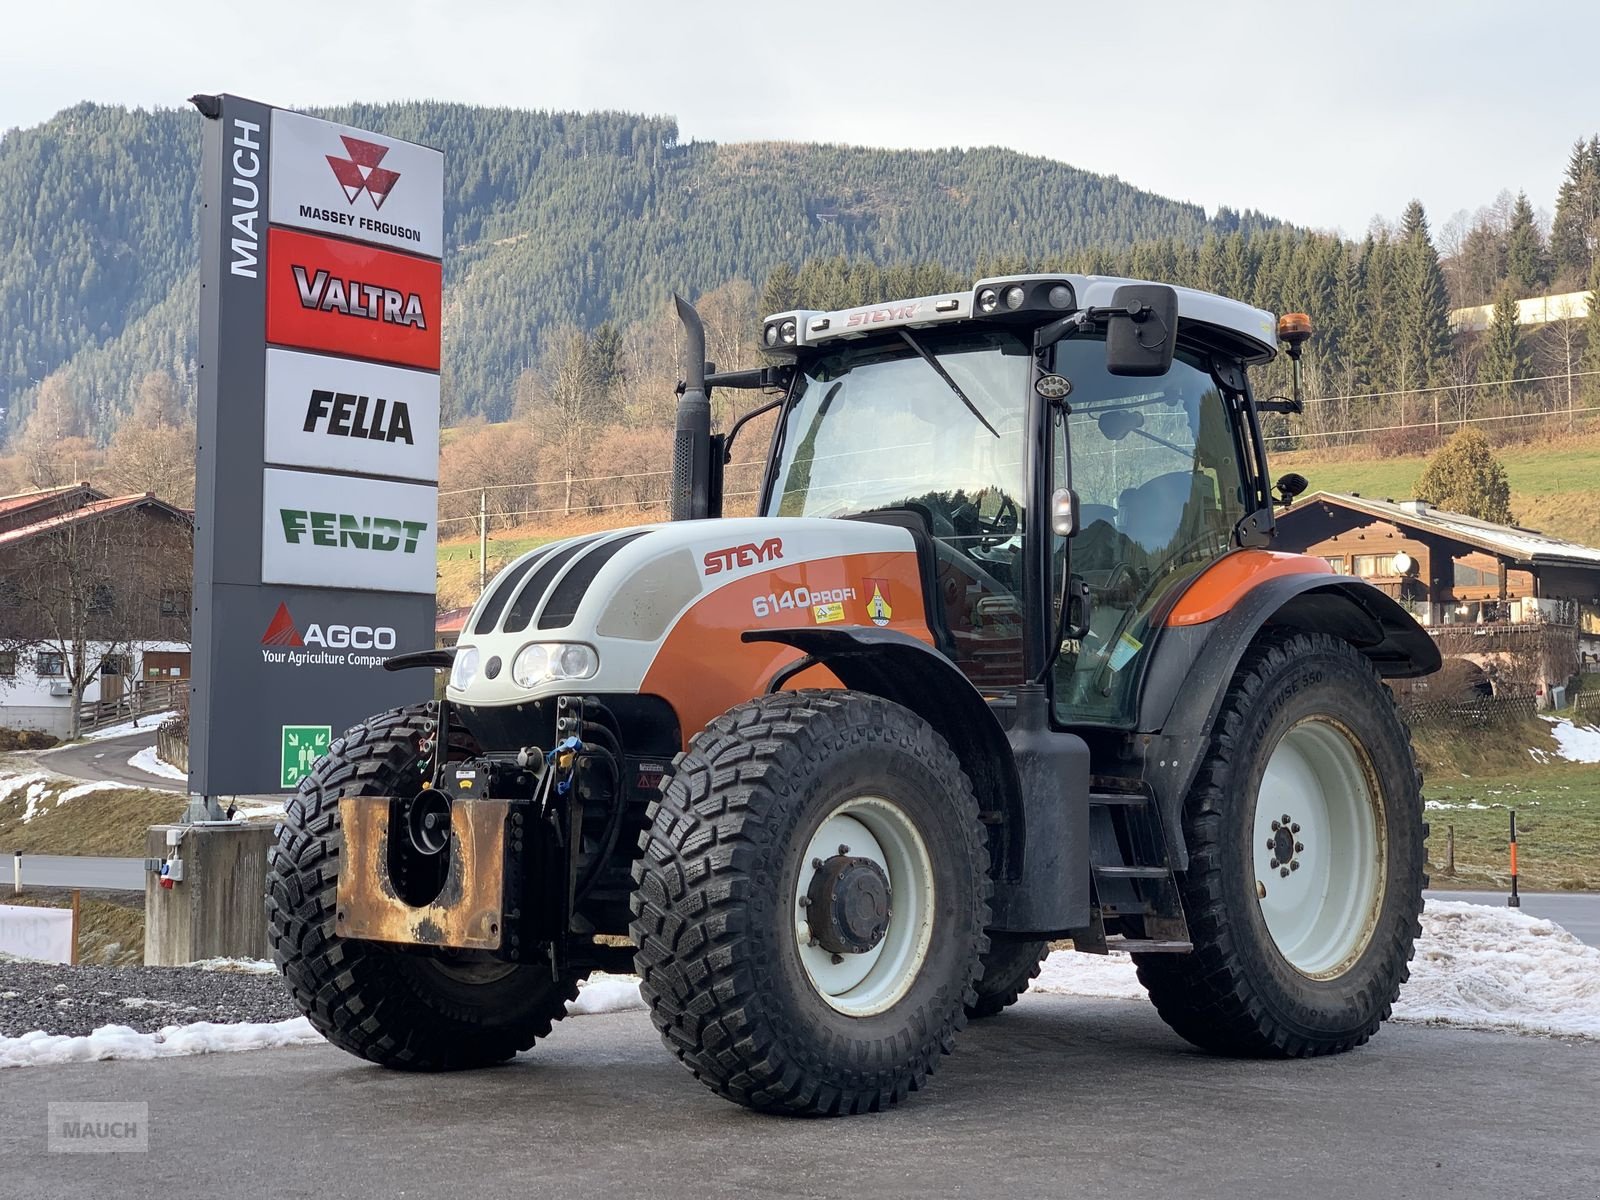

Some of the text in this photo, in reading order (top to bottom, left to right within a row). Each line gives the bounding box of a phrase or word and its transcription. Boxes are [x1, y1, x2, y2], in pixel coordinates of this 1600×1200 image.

[231, 119, 260, 278] MAUCH
[300, 205, 421, 242] MASSEY FERGUSON
[291, 265, 427, 329] VALTRA
[847, 304, 920, 327] STEYR
[303, 389, 414, 445] FELLA
[280, 508, 428, 554] FENDT
[704, 537, 784, 575] STEYR
[304, 624, 396, 650] AGCO
[262, 650, 285, 663] Your
[288, 650, 345, 666] Agriculture
[1302, 670, 1323, 687] 550
